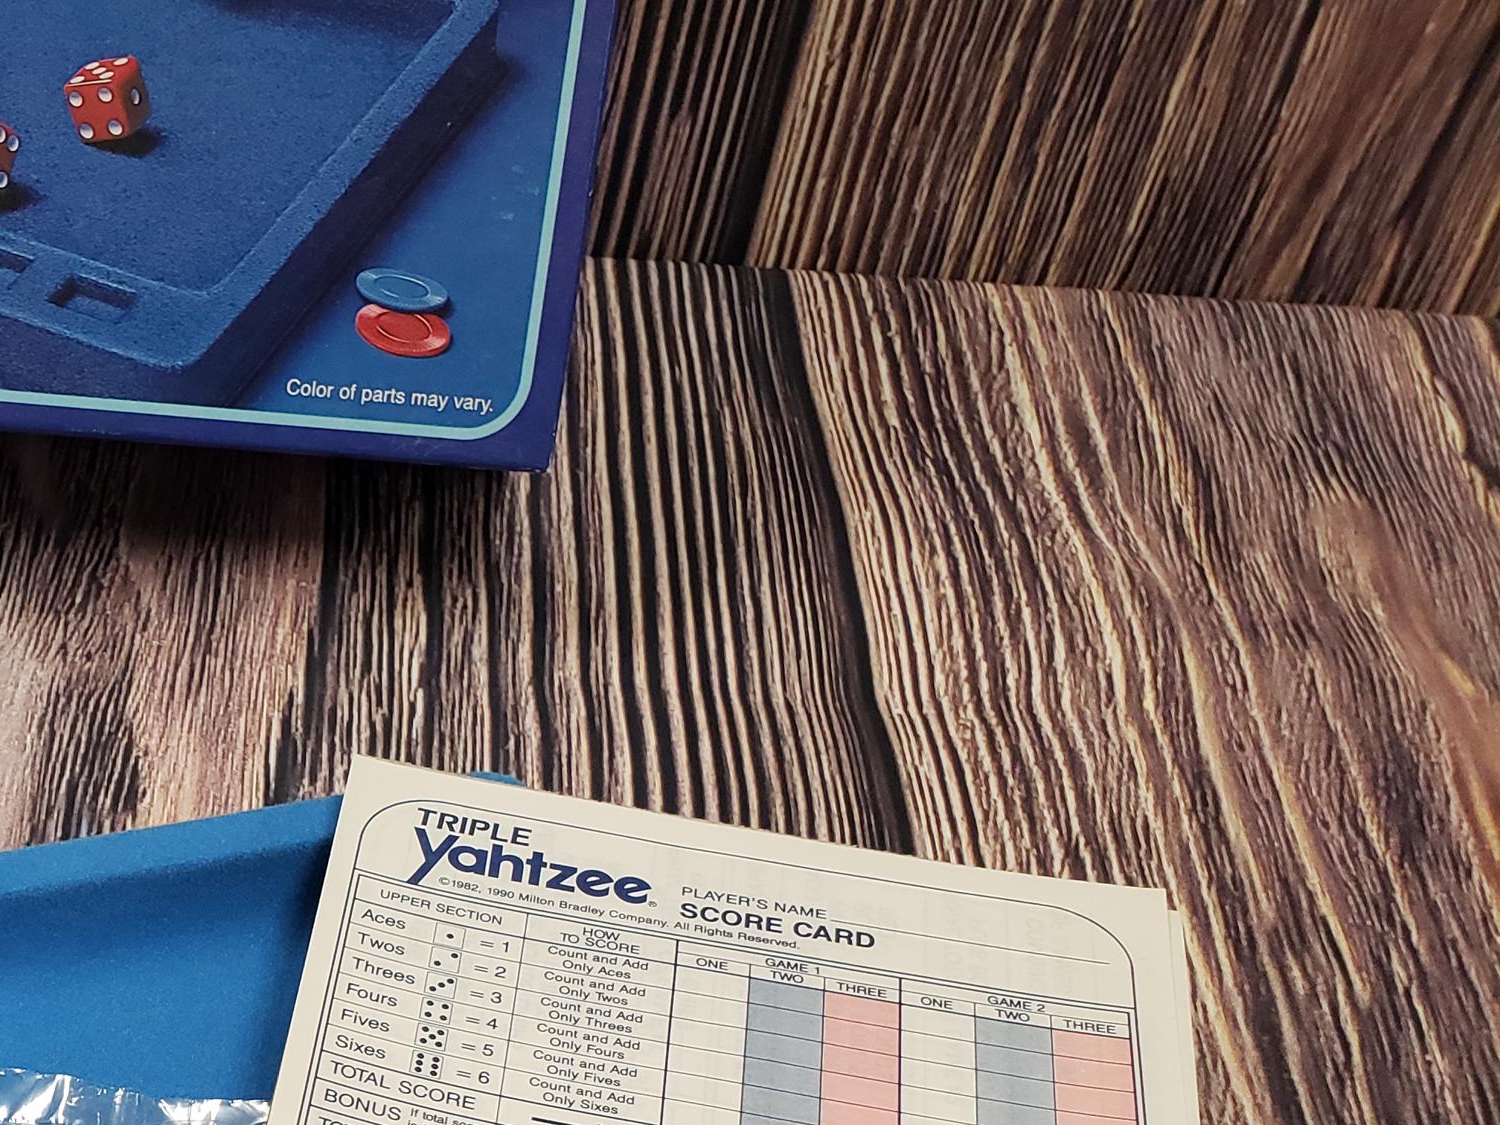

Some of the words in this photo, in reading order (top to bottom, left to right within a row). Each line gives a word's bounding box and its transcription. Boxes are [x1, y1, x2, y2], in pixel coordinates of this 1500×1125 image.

[286, 378, 334, 399] Color
[339, 383, 357, 401] of
[361, 386, 405, 407] parts
[411, 392, 449, 411] may
[454, 395, 494, 416] vary.
[417, 807, 533, 847] TRIPLE
[380, 888, 431, 910] UPPER
[435, 902, 503, 926] SECTION
[681, 886, 769, 910] PLAYER'S
[774, 901, 827, 920] NAME
[360, 908, 406, 930] Aces
[487, 887, 515, 899] 1990
[518, 892, 555, 907] Milton
[558, 900, 606, 918] Bradley
[608, 909, 669, 929] Company.
[673, 921, 690, 931] All
[693, 924, 734, 939] Rights
[737, 931, 801, 950] Reserved.
[679, 902, 783, 934] SCORE
[792, 921, 876, 949] CARD
[357, 931, 405, 956] Twos
[559, 931, 580, 945] TO
[583, 936, 642, 956] SCORE
[582, 927, 621, 943] HOW
[352, 956, 416, 985] Threes
[547, 945, 588, 961] Count
[592, 954, 618, 966] and
[621, 958, 649, 971] Add
[562, 959, 594, 975] Only
[597, 966, 631, 980] Aces
[695, 957, 729, 971] ONE
[764, 957, 809, 974] GAME
[814, 966, 820, 975] 1
[769, 969, 804, 984] TWO
[346, 982, 398, 1007] Fours
[835, 981, 887, 999] THREE
[920, 996, 954, 1010] ONE
[987, 995, 1033, 1011] GAME
[1036, 1003, 1046, 1013] 2
[994, 1008, 1030, 1022] TWO
[340, 1008, 390, 1033] Fives
[1062, 1018, 1117, 1035] THREE
[335, 1034, 387, 1060] Sixes
[329, 1059, 391, 1090] TOTAL
[398, 1080, 477, 1111] SCORE
[529, 1076, 572, 1094] Count
[575, 1088, 603, 1100] and
[606, 1092, 636, 1105] Add
[323, 1087, 402, 1121] BONUS
[542, 1091, 576, 1109] Only
[579, 1099, 619, 1115] Sixes
